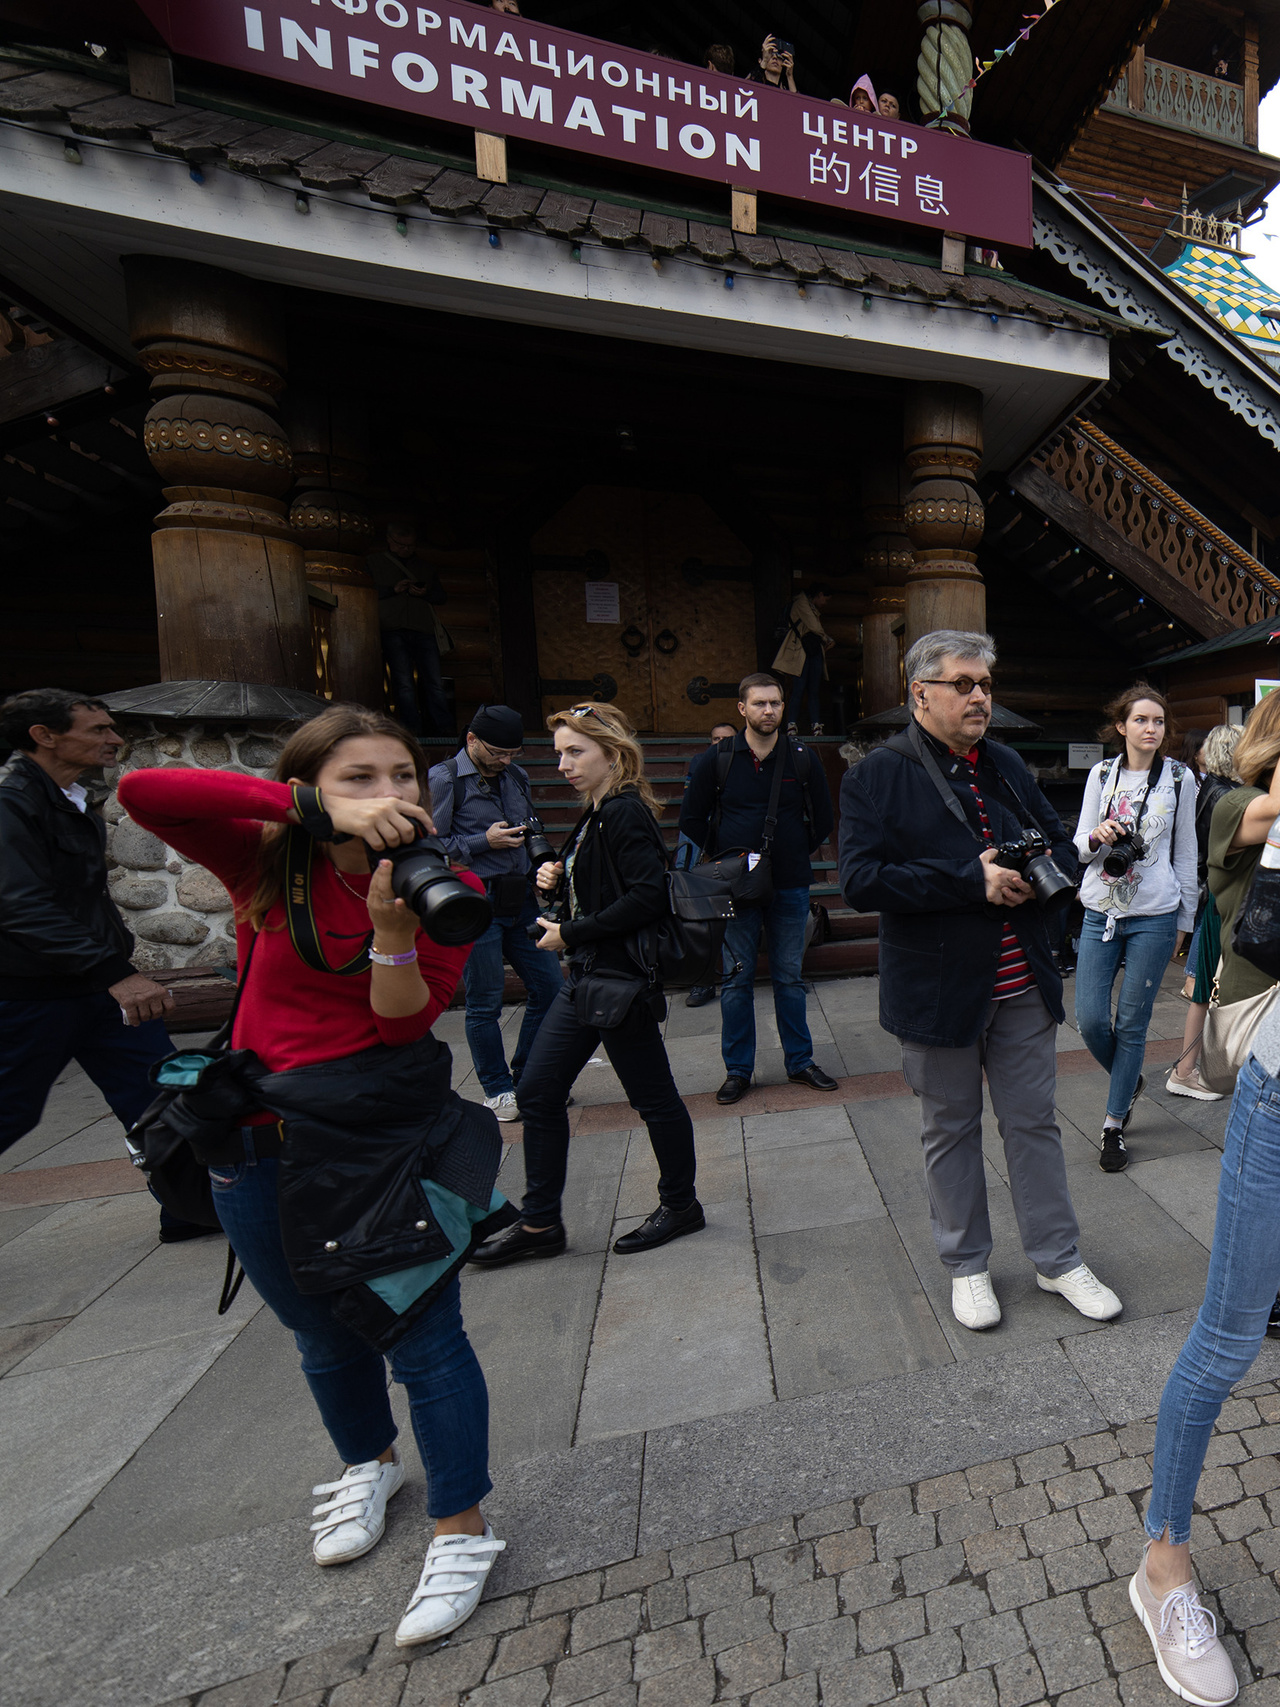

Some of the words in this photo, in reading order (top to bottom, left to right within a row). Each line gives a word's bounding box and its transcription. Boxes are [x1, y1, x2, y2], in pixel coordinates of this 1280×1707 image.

[243, 6, 761, 172] INFORMATION
[311, 0, 758, 122] ФОРМАЦИОННЫЙ
[802, 111, 919, 159] ЦЕНТР
[809, 148, 950, 217] 的信息
[1136, 785, 1174, 797] NGHT
